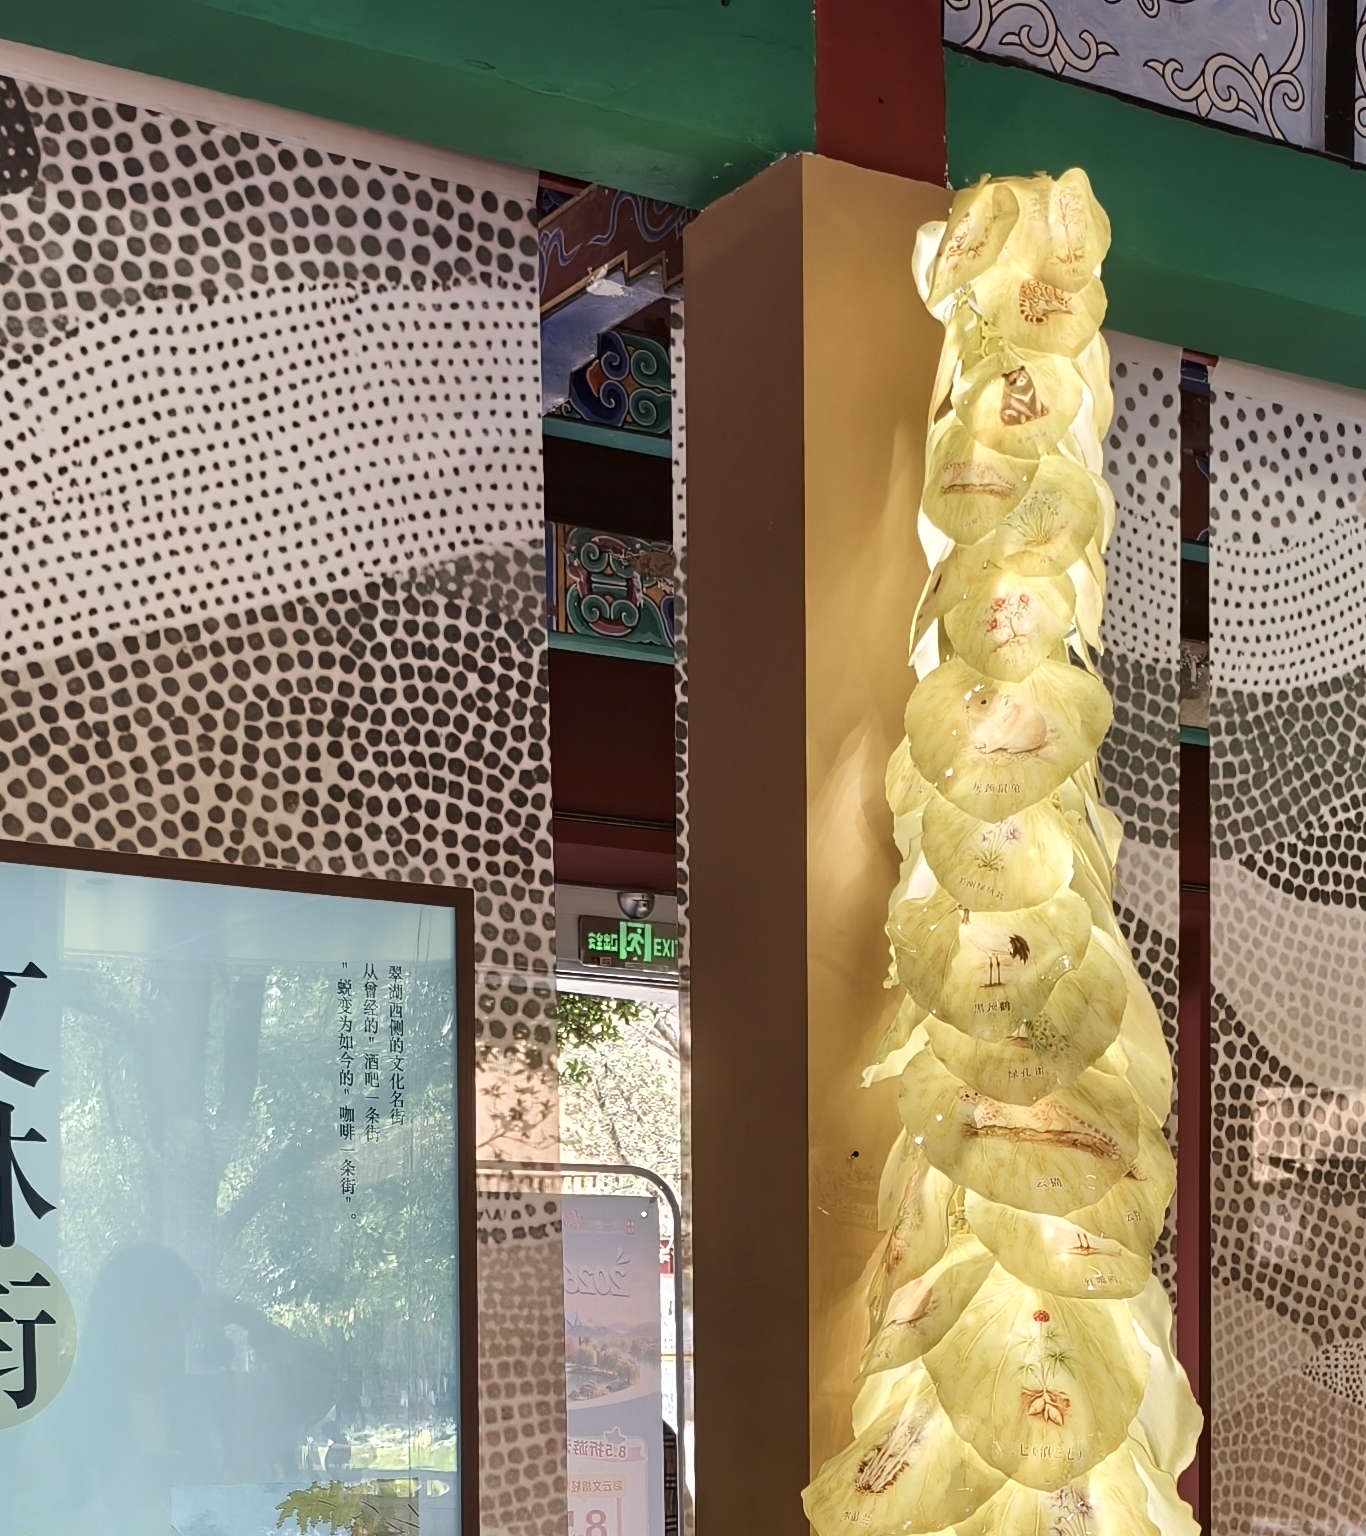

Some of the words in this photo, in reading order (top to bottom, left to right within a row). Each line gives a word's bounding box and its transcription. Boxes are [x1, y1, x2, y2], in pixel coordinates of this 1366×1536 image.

[654, 938, 679, 958] EXI
[388, 965, 406, 1126] 翠湖西侧的文化名街
